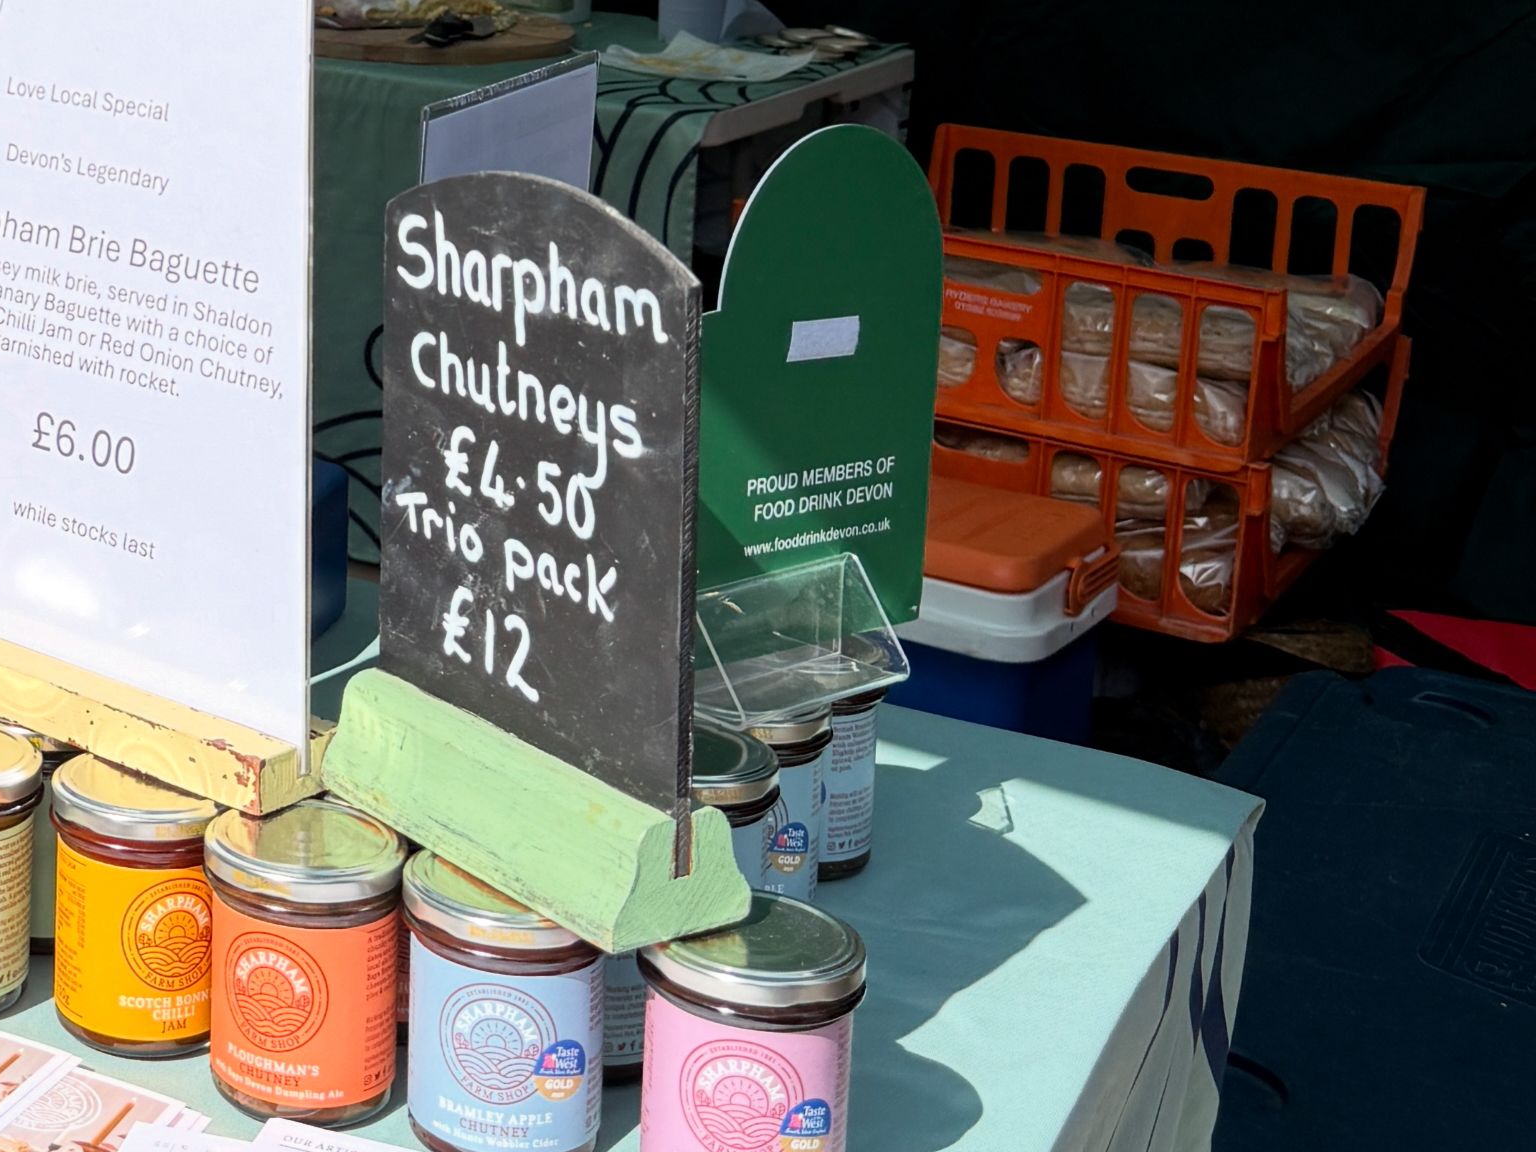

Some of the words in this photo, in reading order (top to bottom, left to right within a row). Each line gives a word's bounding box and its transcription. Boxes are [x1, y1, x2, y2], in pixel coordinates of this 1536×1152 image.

[6, 76, 46, 101] Love
[51, 82, 98, 110] Local
[102, 92, 170, 123] Special
[6, 143, 72, 174] Devon's
[77, 156, 170, 195] Legendary
[69, 224, 121, 263] Brie
[129, 238, 260, 294] Baguette
[396, 209, 669, 347] Sharpham
[25, 263, 61, 286] milk
[65, 272, 103, 300] brie,
[107, 284, 167, 313] served
[172, 296, 189, 316] in
[193, 301, 273, 338] Shaldon
[45, 292, 122, 329] Baguette
[126, 313, 164, 337] with
[168, 325, 179, 342] a
[184, 328, 248, 360] choice
[253, 345, 274, 365] of
[38, 317, 73, 343] Jam
[77, 329, 95, 347] or
[99, 332, 135, 358] Red
[139, 342, 194, 374] Onion
[199, 359, 284, 400] Chutney,
[78, 355, 115, 380] with
[119, 366, 180, 398] rocket.
[410, 330, 644, 490] Chutneys
[31, 411, 136, 475] £6.00
[443, 424, 597, 540] £4.50
[746, 471, 799, 497] PROUD
[801, 459, 873, 487] MEMBERS
[875, 456, 896, 474] OF
[753, 499, 803, 523] FOOD
[799, 489, 843, 515] DRINK
[846, 481, 894, 506] DEVON
[12, 499, 57, 527] while
[61, 514, 119, 548] stocks
[122, 531, 156, 560] last
[396, 491, 484, 564] Trio
[743, 517, 892, 558] www.fooddrinkdevon.co.uk
[441, 585, 540, 703] £12
[785, 837, 804, 848] West
[787, 828, 806, 838] Taste
[777, 855, 802, 865] GOLD
[141, 895, 209, 932] SHARPHAM
[144, 970, 175, 989] FARM
[178, 966, 204, 987] SHOP
[236, 951, 309, 994] SHARPHAM
[118, 994, 172, 1009] SCOTCH
[152, 1005, 196, 1021] CHILLI
[161, 1019, 188, 1034] JAM
[454, 1002, 538, 1042] SHARPHAM
[226, 1040, 321, 1076] PLOUGHMAN'S
[270, 1034, 301, 1049] SHOP
[555, 1046, 580, 1056] Taste
[239, 1061, 302, 1088] CHUTNEY
[554, 1057, 578, 1069] West
[699, 1059, 786, 1100] SHARPHAM
[460, 1075, 494, 1101] FARM
[497, 1085, 530, 1102] SHOP
[544, 1078, 574, 1089] GOLD
[438, 1095, 506, 1126] BRAMLEY
[507, 1111, 554, 1126] APPLE
[458, 1117, 530, 1139] CHUTNEY
[800, 1117, 825, 1129] West
[803, 1105, 827, 1117] Taste
[789, 1138, 820, 1151] GOLD
